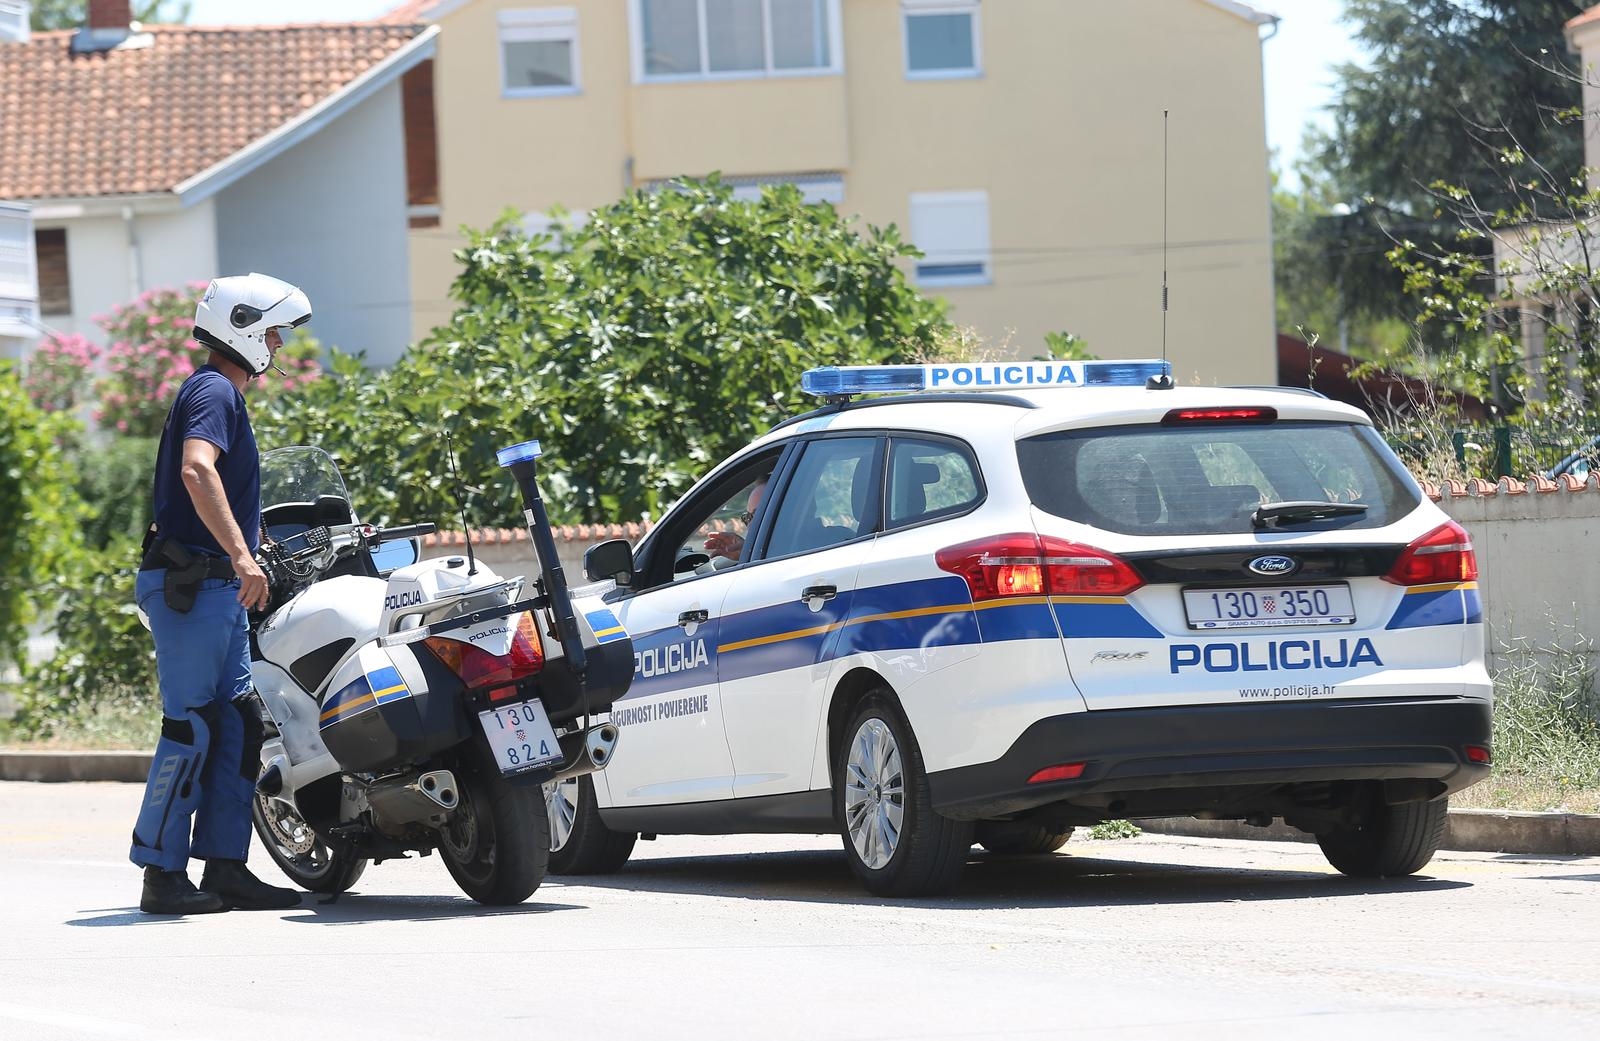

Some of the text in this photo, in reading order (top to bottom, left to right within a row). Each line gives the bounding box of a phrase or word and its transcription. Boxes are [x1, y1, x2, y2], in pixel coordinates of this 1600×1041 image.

[931, 365, 1077, 387] POLICIJA
[1260, 558, 1287, 571] Ford
[384, 590, 422, 611] POLICIJA
[1212, 589, 1330, 619] 130 350
[1169, 637, 1384, 674] POLICIJA
[1239, 684, 1336, 699] www.policija.hr
[495, 705, 535, 729] 130
[609, 694, 709, 727] SIGURNOST I POVJERENJE
[507, 739, 551, 765] 824
